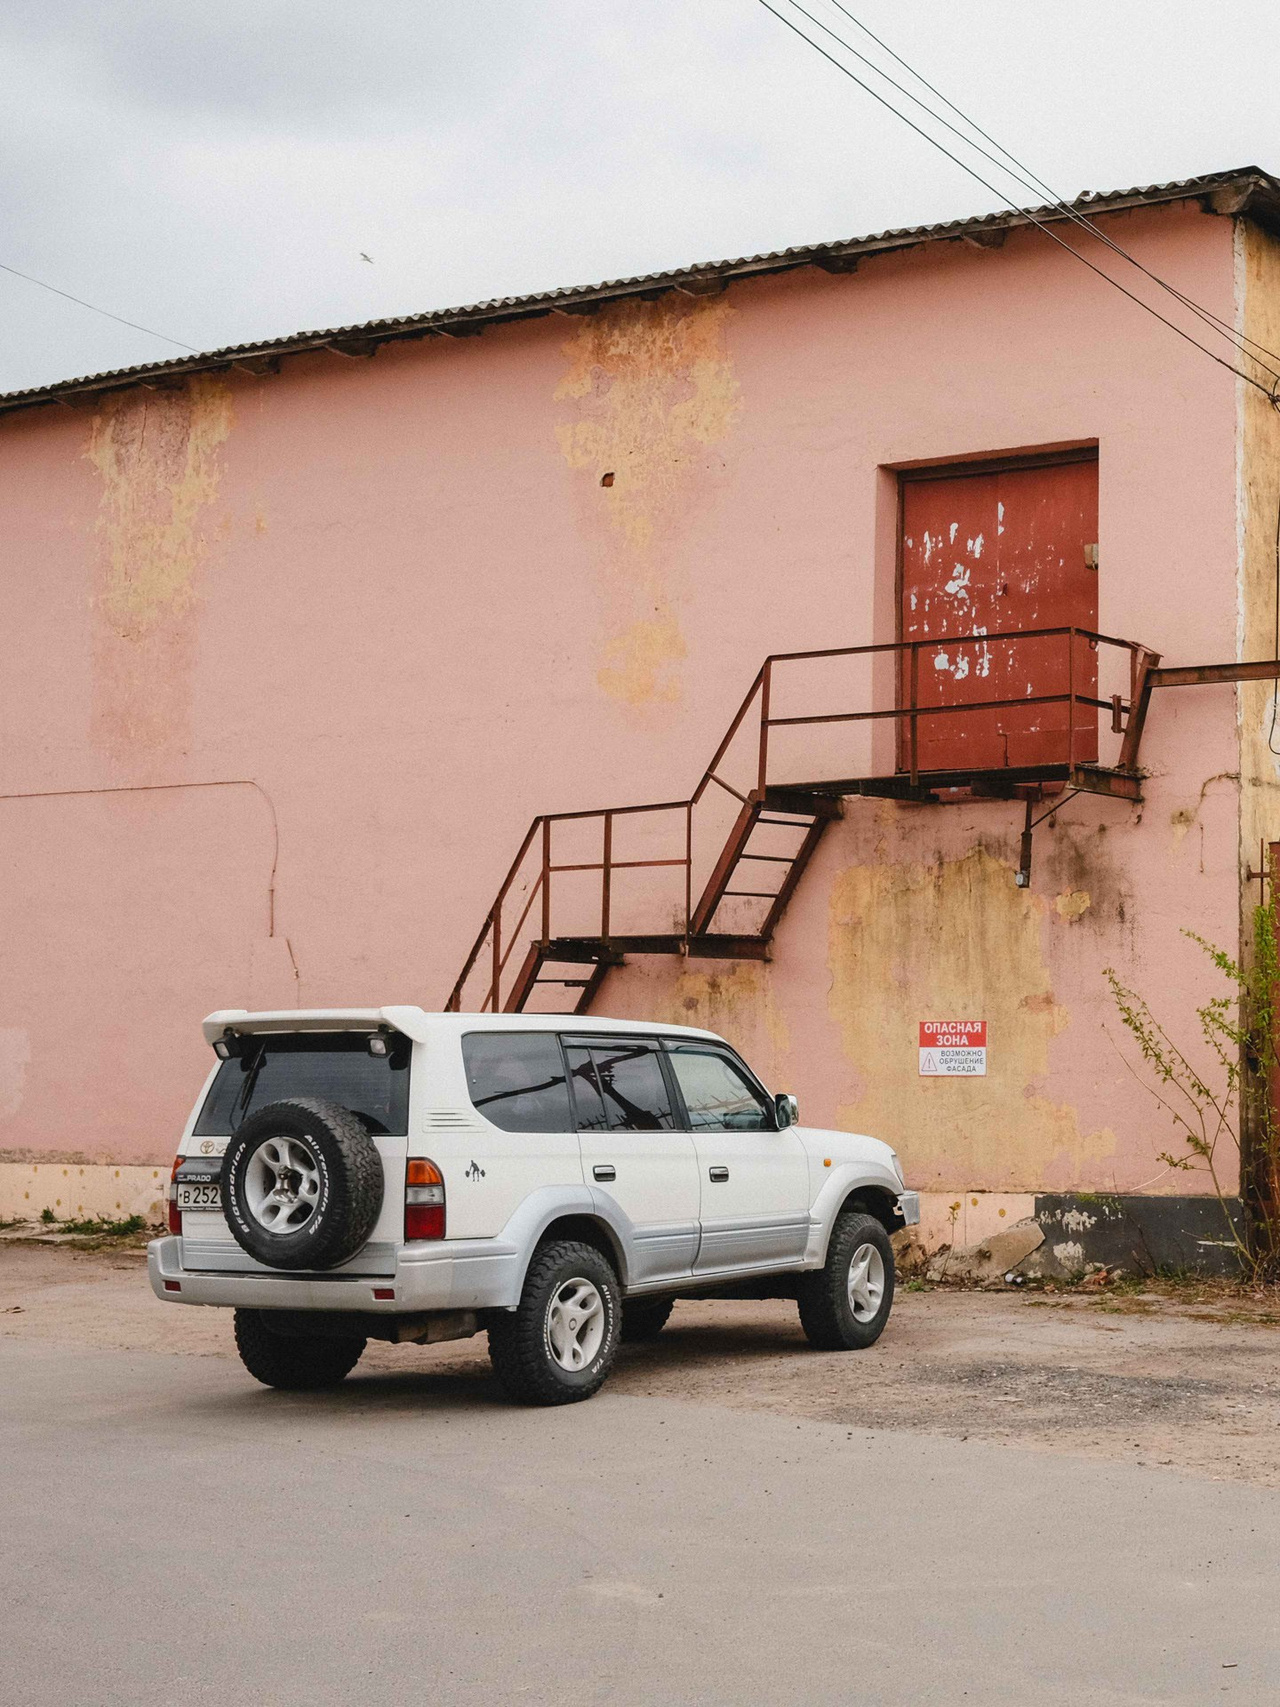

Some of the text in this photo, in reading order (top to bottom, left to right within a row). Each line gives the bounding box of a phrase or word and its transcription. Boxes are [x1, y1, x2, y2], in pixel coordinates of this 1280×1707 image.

[924, 1022, 982, 1033] ОПАСНАЯ
[936, 1035, 969, 1046] ЗОНА
[946, 1065, 977, 1073] ФАСАДА
[186, 1174, 212, 1182] PRADO
